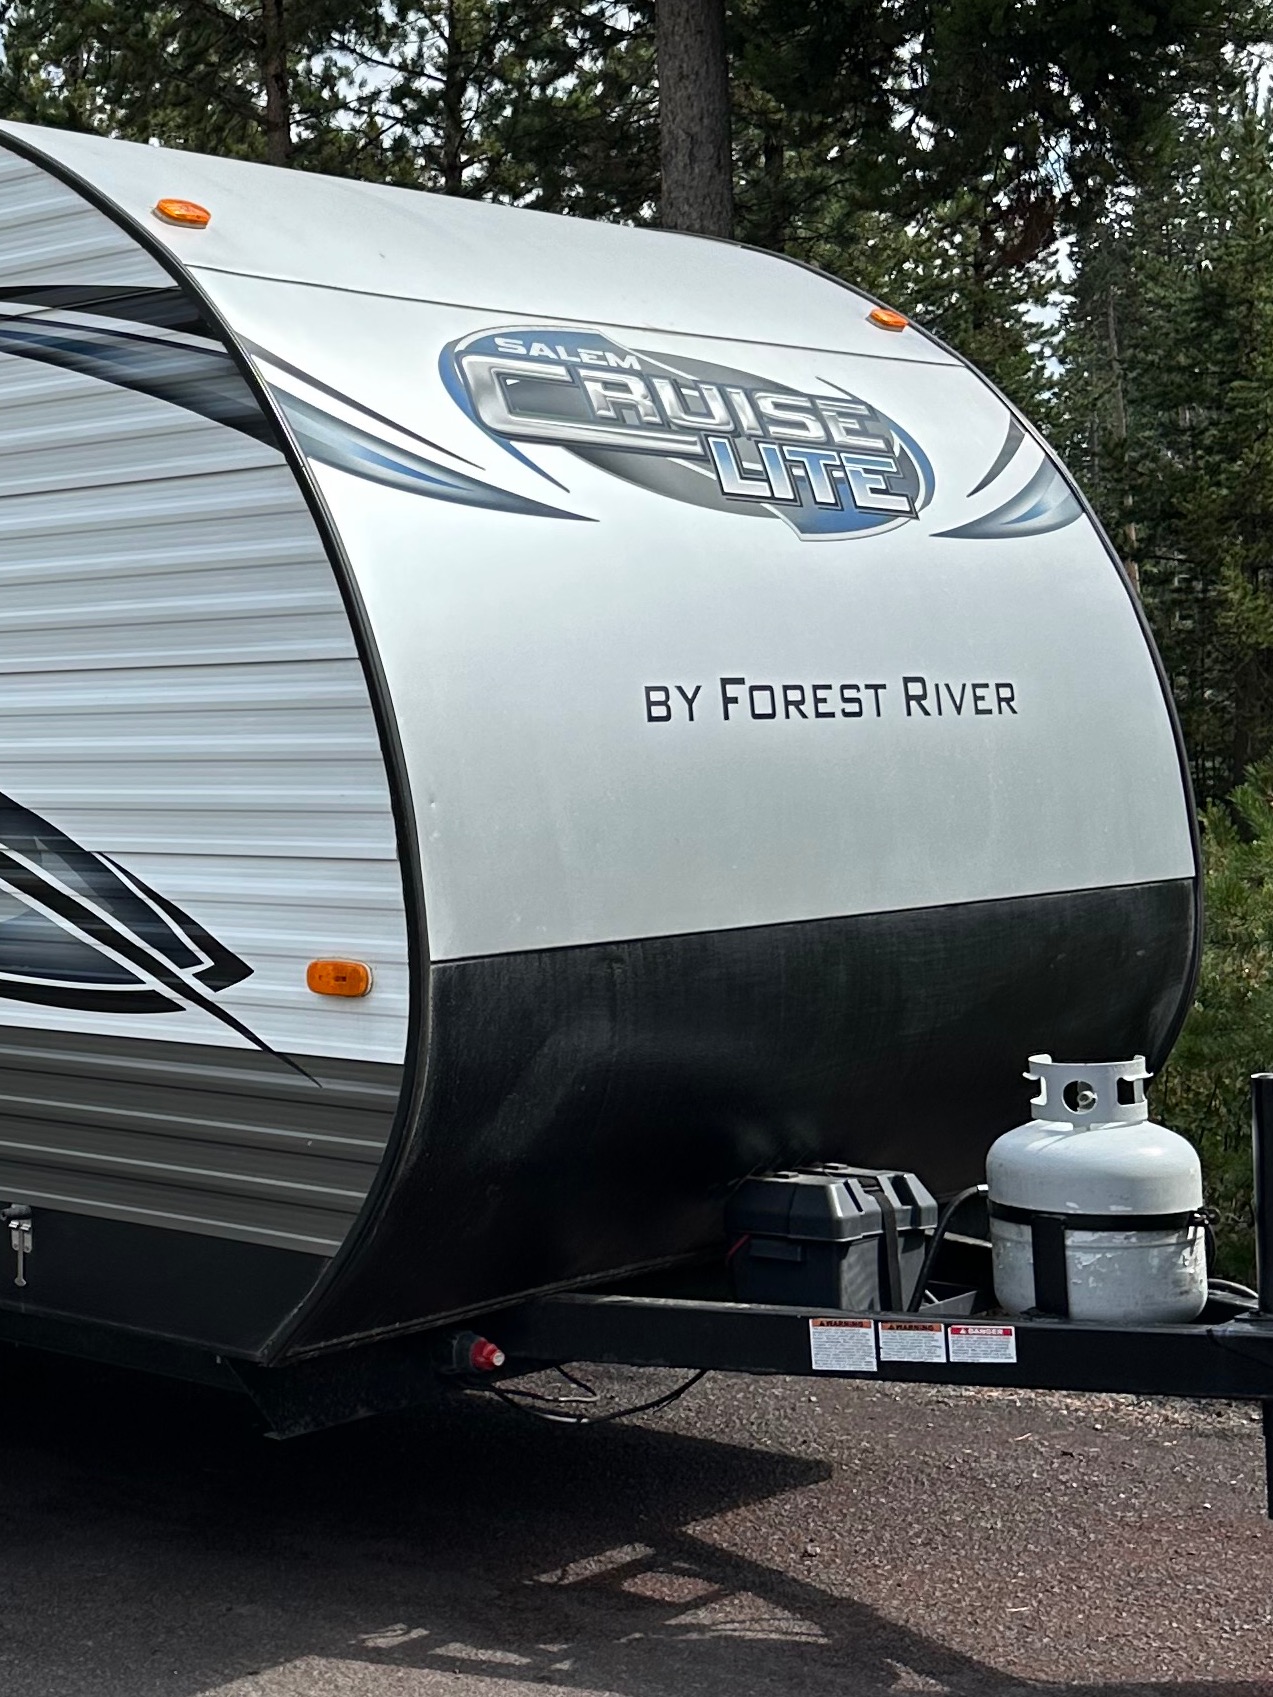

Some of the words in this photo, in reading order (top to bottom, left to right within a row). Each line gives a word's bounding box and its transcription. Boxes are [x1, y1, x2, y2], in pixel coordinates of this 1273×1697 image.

[494, 337, 642, 370] SALEM
[461, 354, 889, 456] CRUISE
[706, 436, 916, 517] LITE
[644, 684, 701, 723] BY
[719, 677, 887, 721] FOREST
[902, 675, 1018, 716] RIVER
